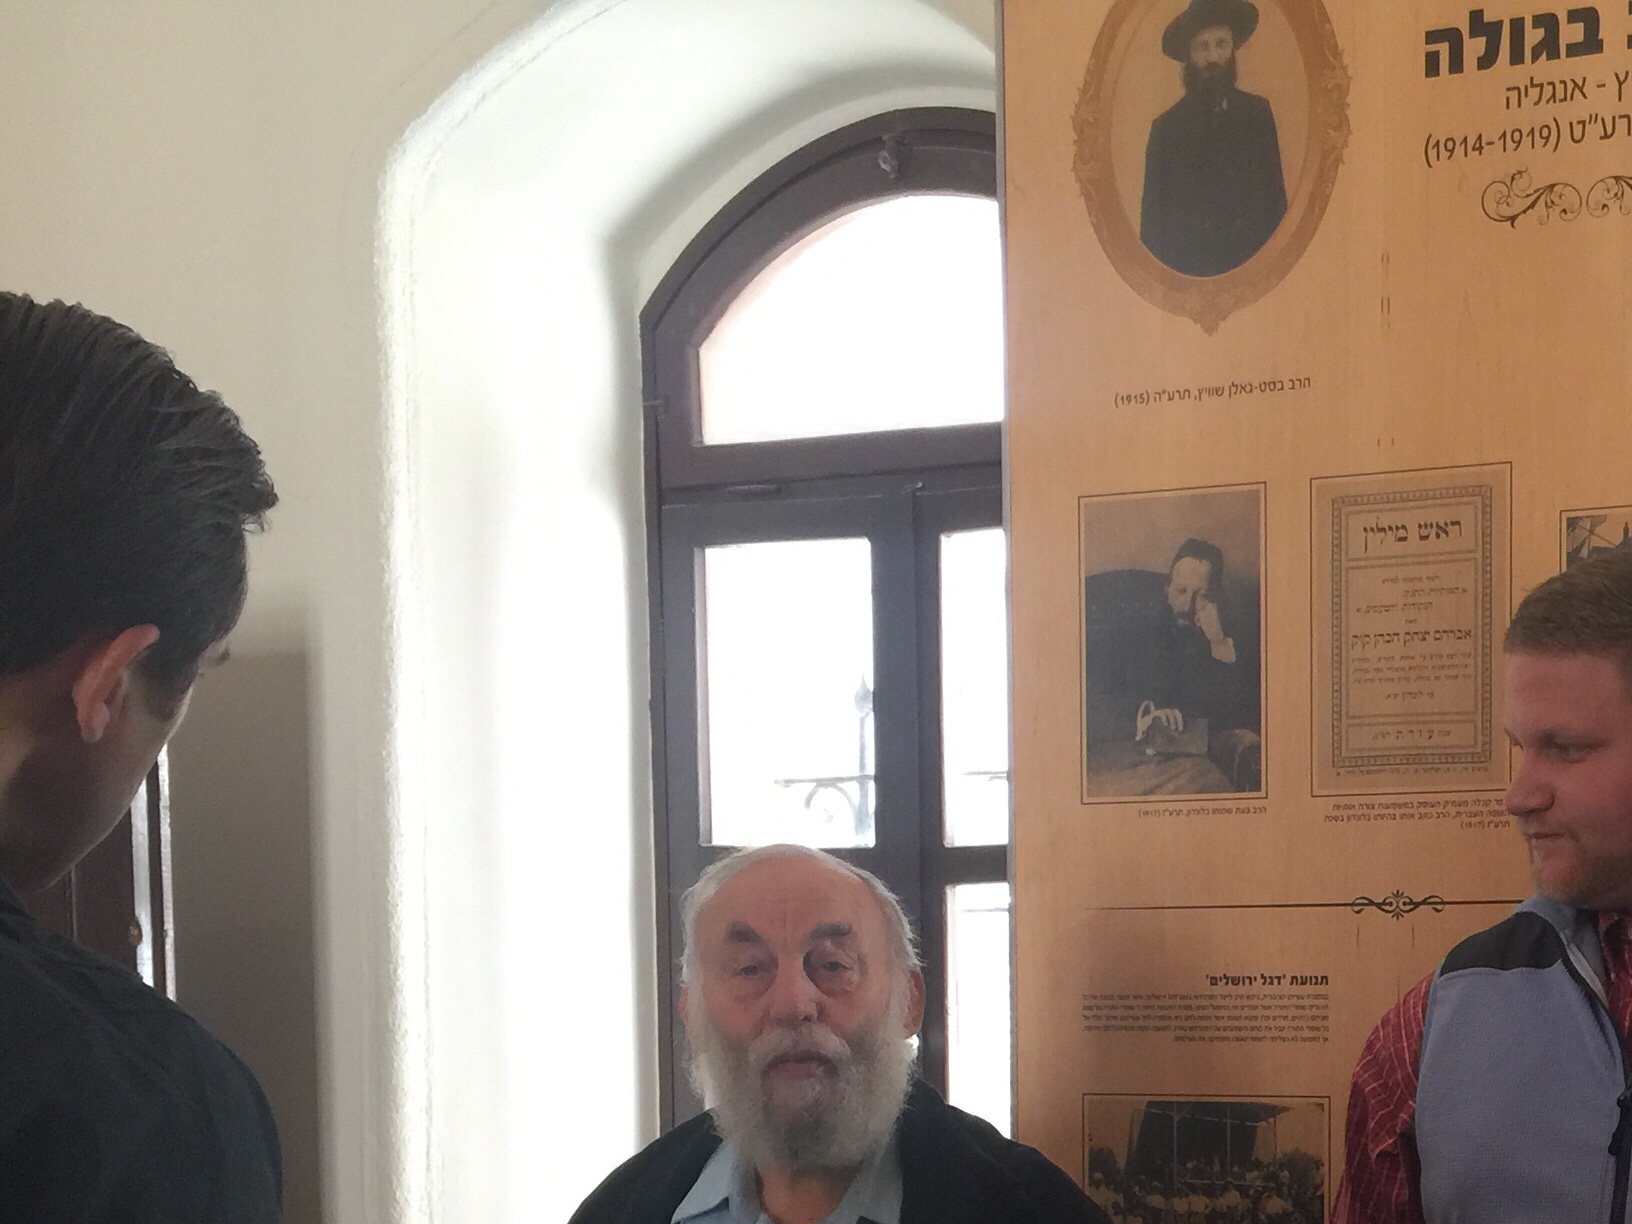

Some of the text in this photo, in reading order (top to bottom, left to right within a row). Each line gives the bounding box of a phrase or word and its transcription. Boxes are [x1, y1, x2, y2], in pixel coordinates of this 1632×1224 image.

[1424, 6, 1604, 78] בגולה
[1505, 76, 1588, 110] אנגליה
[1424, 117, 1562, 168] (1914-1919)
[1288, 377, 1311, 391] הרב
[1114, 390, 1150, 408] (1915)
[1362, 515, 1463, 553] ראש מילין
[1351, 634, 1371, 650] קוק
[1433, 629, 1473, 641] אברהם
[1290, 974, 1329, 986] תנועת
